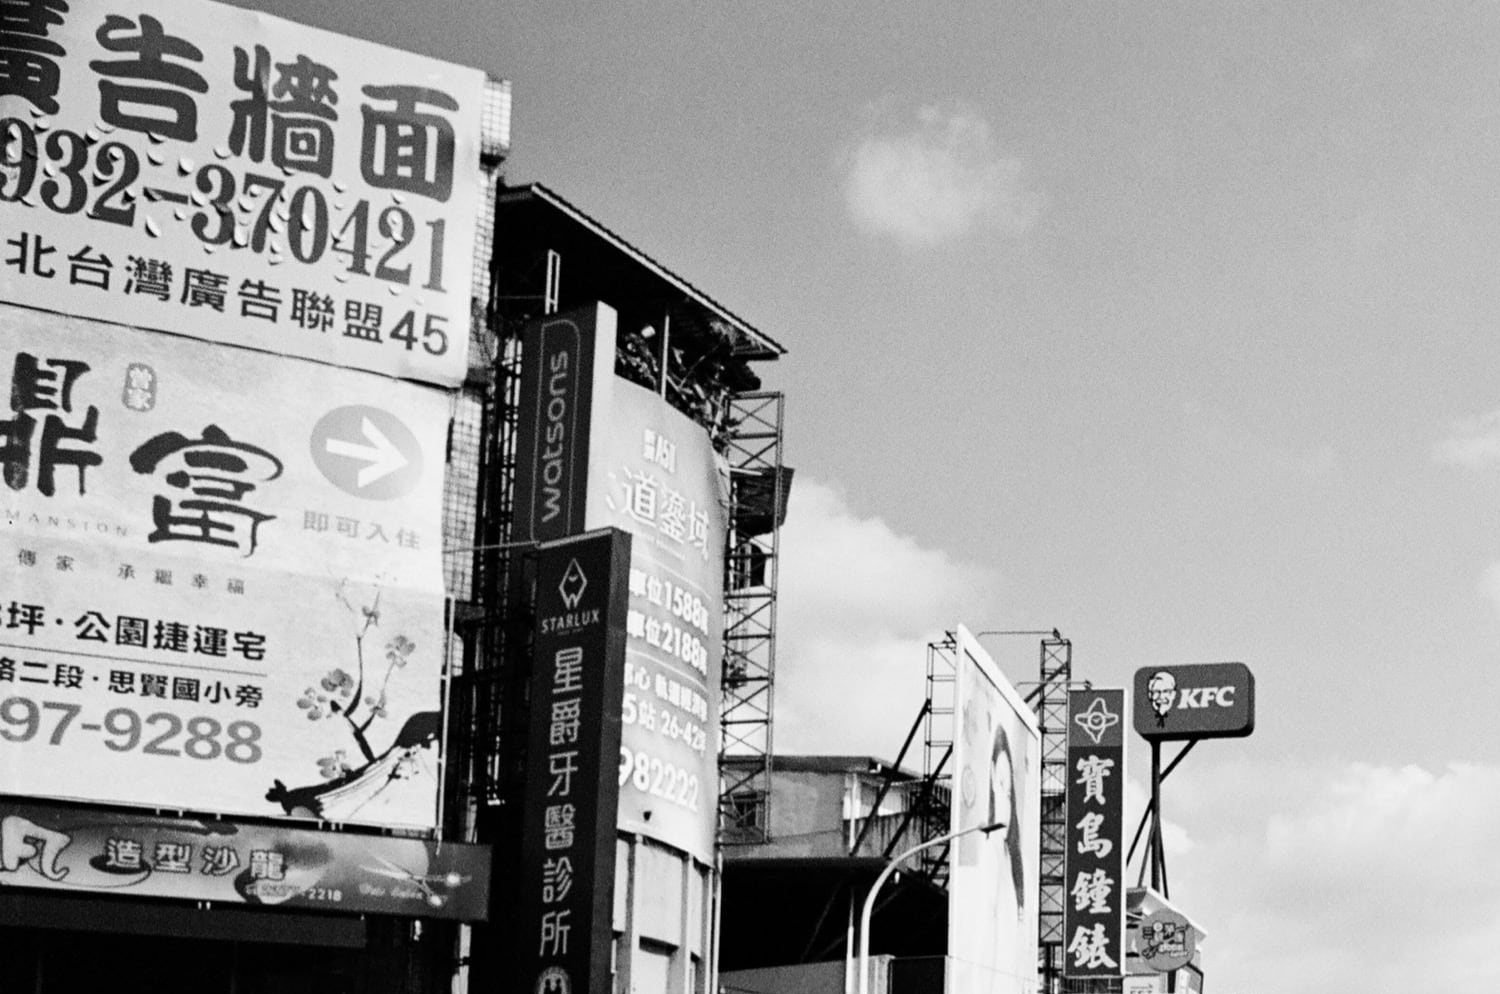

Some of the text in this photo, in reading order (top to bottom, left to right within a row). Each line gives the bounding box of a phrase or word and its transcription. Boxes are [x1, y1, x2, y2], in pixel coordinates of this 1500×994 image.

[542, 348, 570, 522] watsons
[303, 511, 421, 549] 即可入住
[0, 601, 266, 661] 坪·公園捷運宅
[541, 609, 600, 634] STARLUX
[1178, 685, 1236, 710] KFC
[0, 696, 263, 764] 97-9288
[539, 646, 583, 957] 星爵牙醫診所
[105, 838, 288, 882] 造型沙龍
[1068, 754, 1119, 970] 寶島鐘錶
